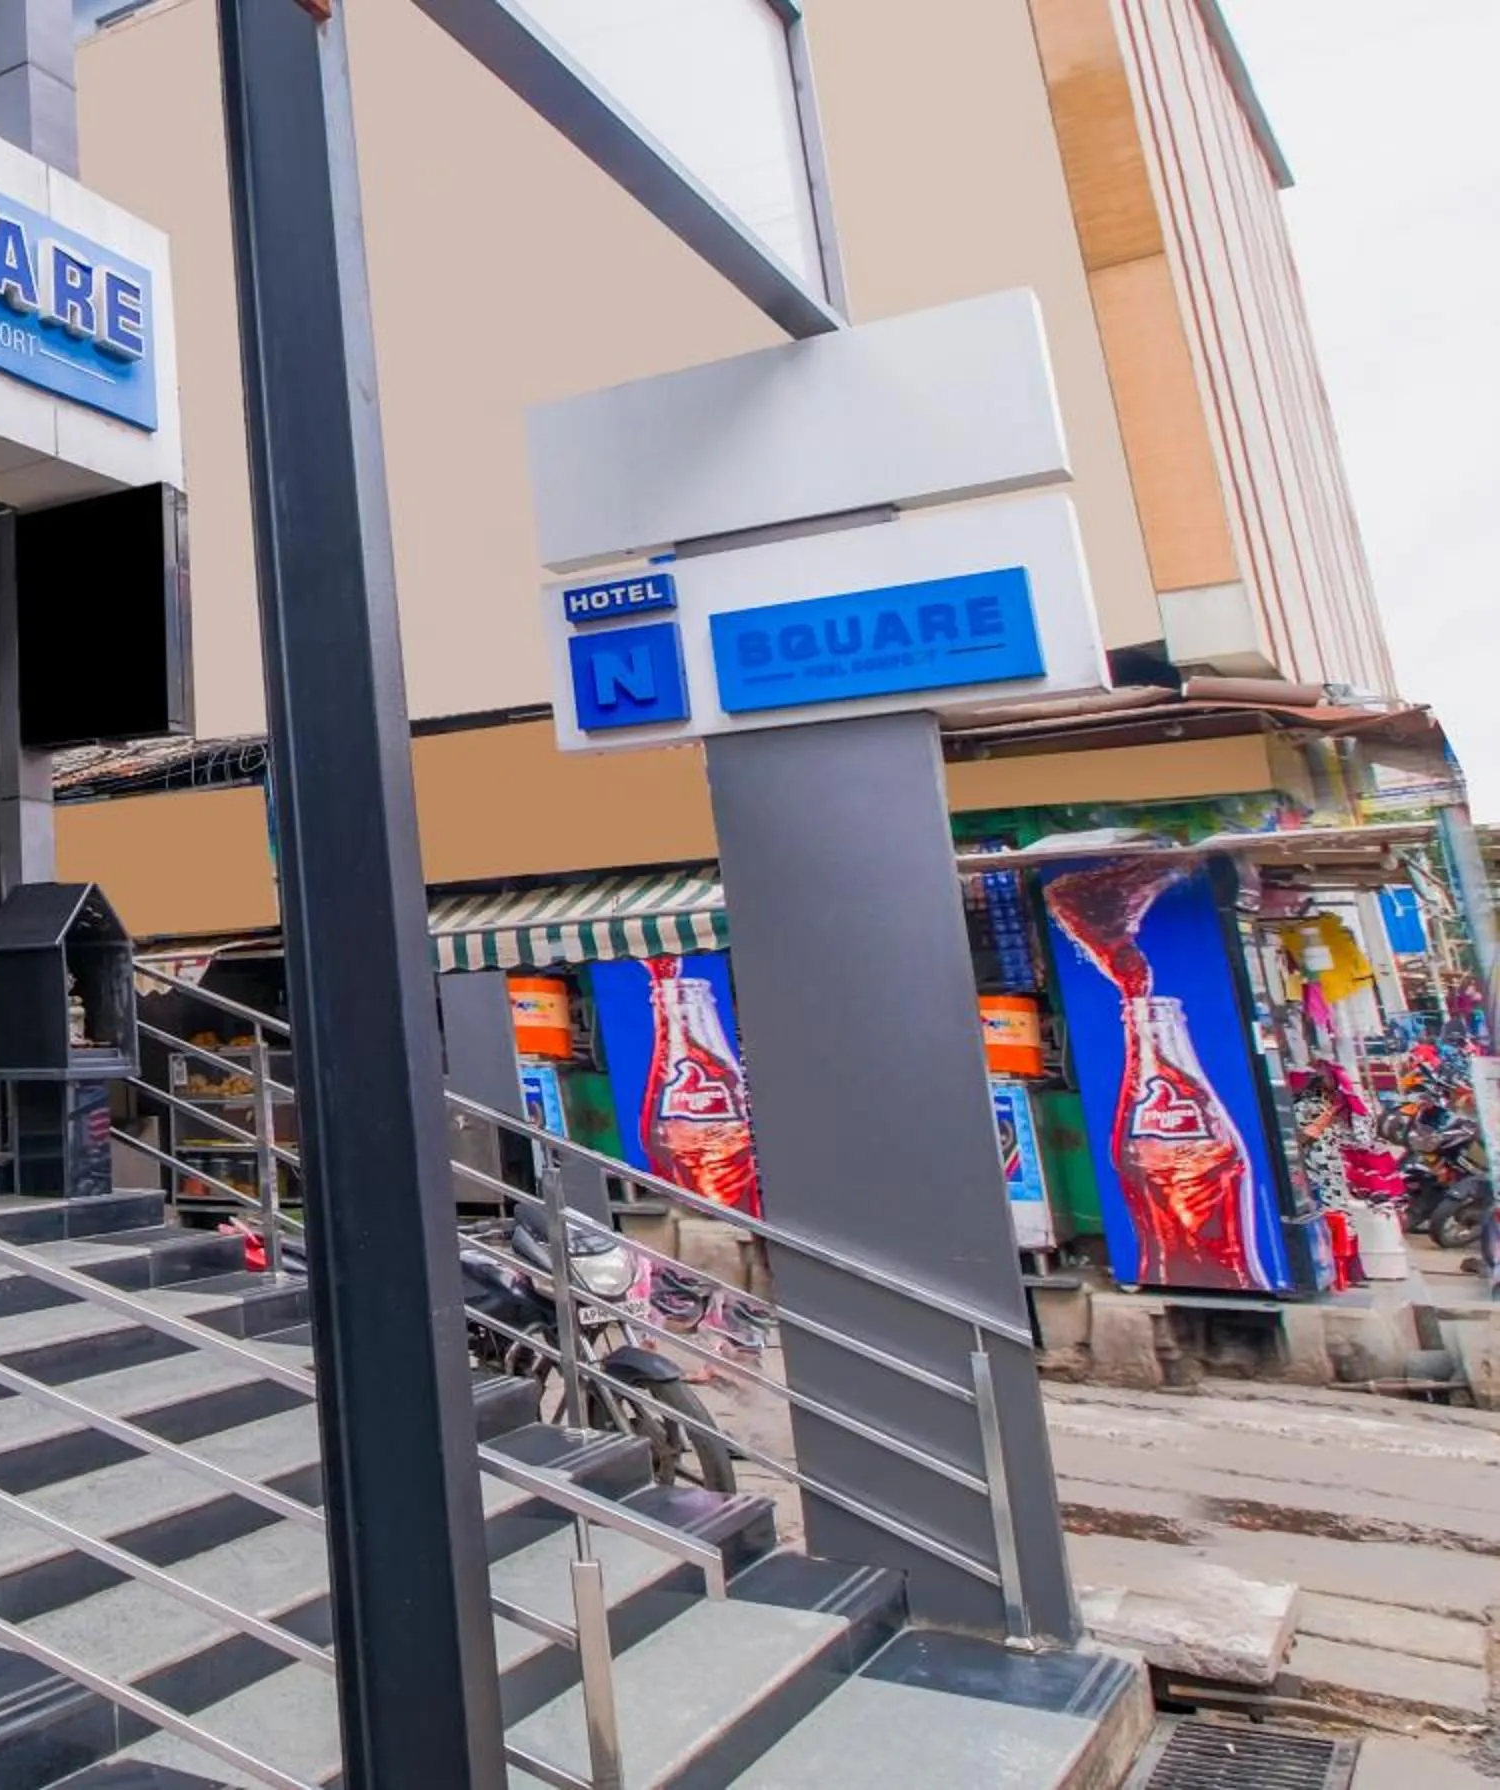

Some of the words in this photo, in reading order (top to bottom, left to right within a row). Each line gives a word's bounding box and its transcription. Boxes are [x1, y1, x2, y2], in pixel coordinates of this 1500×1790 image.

[568, 581, 664, 613] HOTEL
[735, 594, 1006, 670] SQUARE
[589, 645, 658, 706] N
